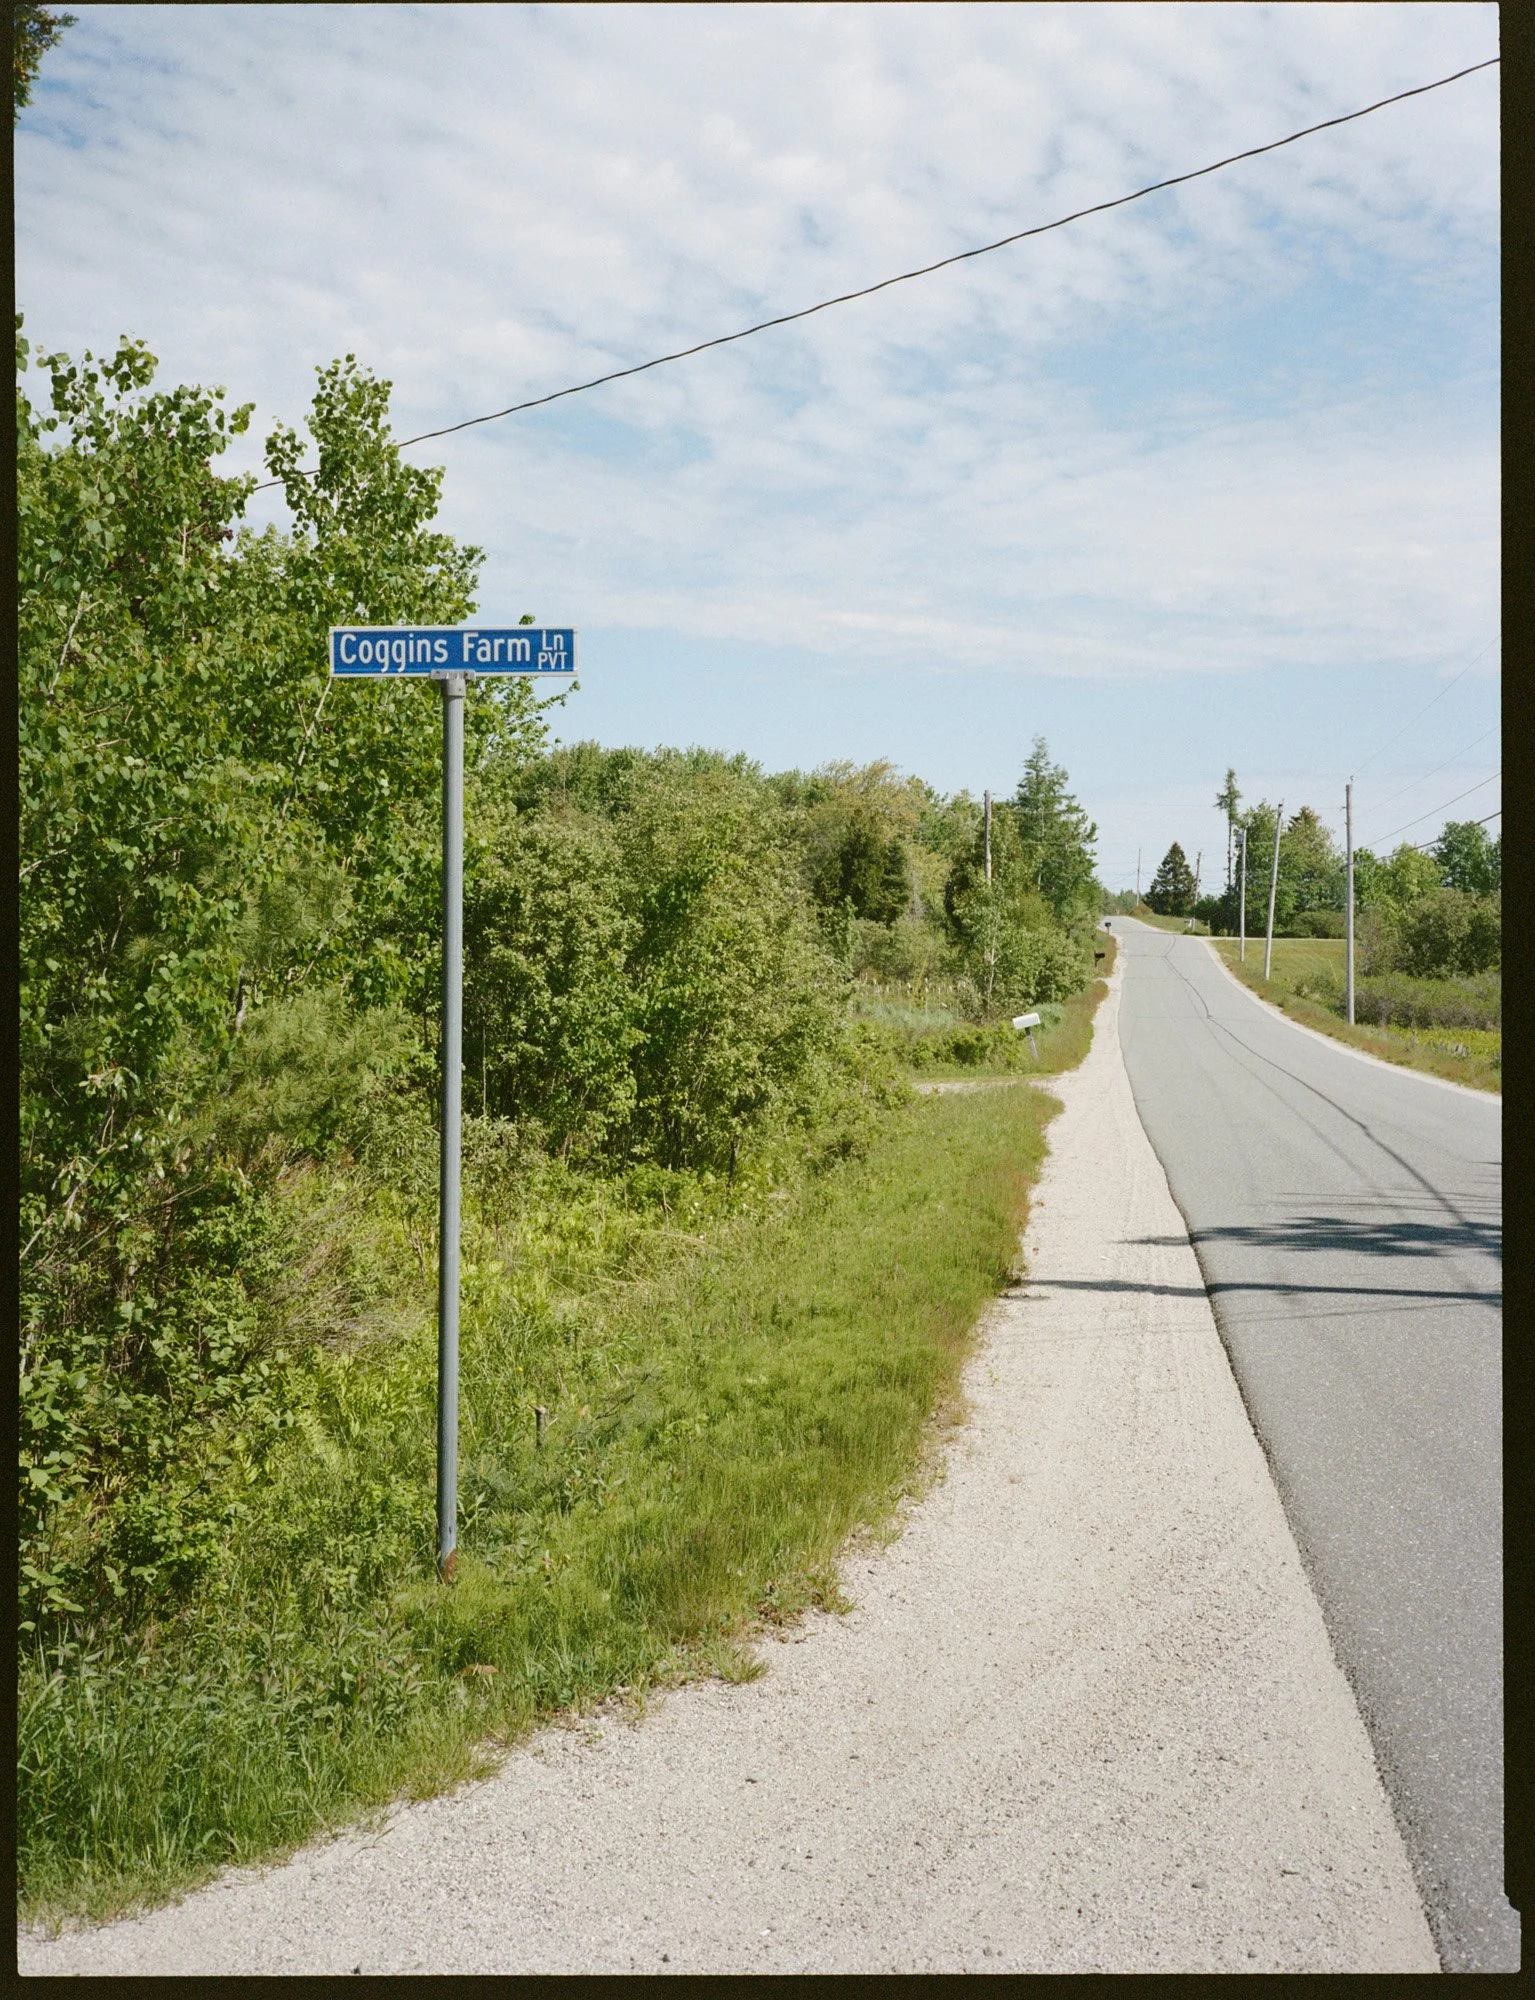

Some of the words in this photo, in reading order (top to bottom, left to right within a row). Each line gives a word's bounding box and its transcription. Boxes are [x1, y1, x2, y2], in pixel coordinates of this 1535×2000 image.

[340, 633, 448, 672] Coggins
[463, 632, 530, 662] Farm
[542, 630, 564, 651] Ln
[538, 652, 567, 670] PVT
